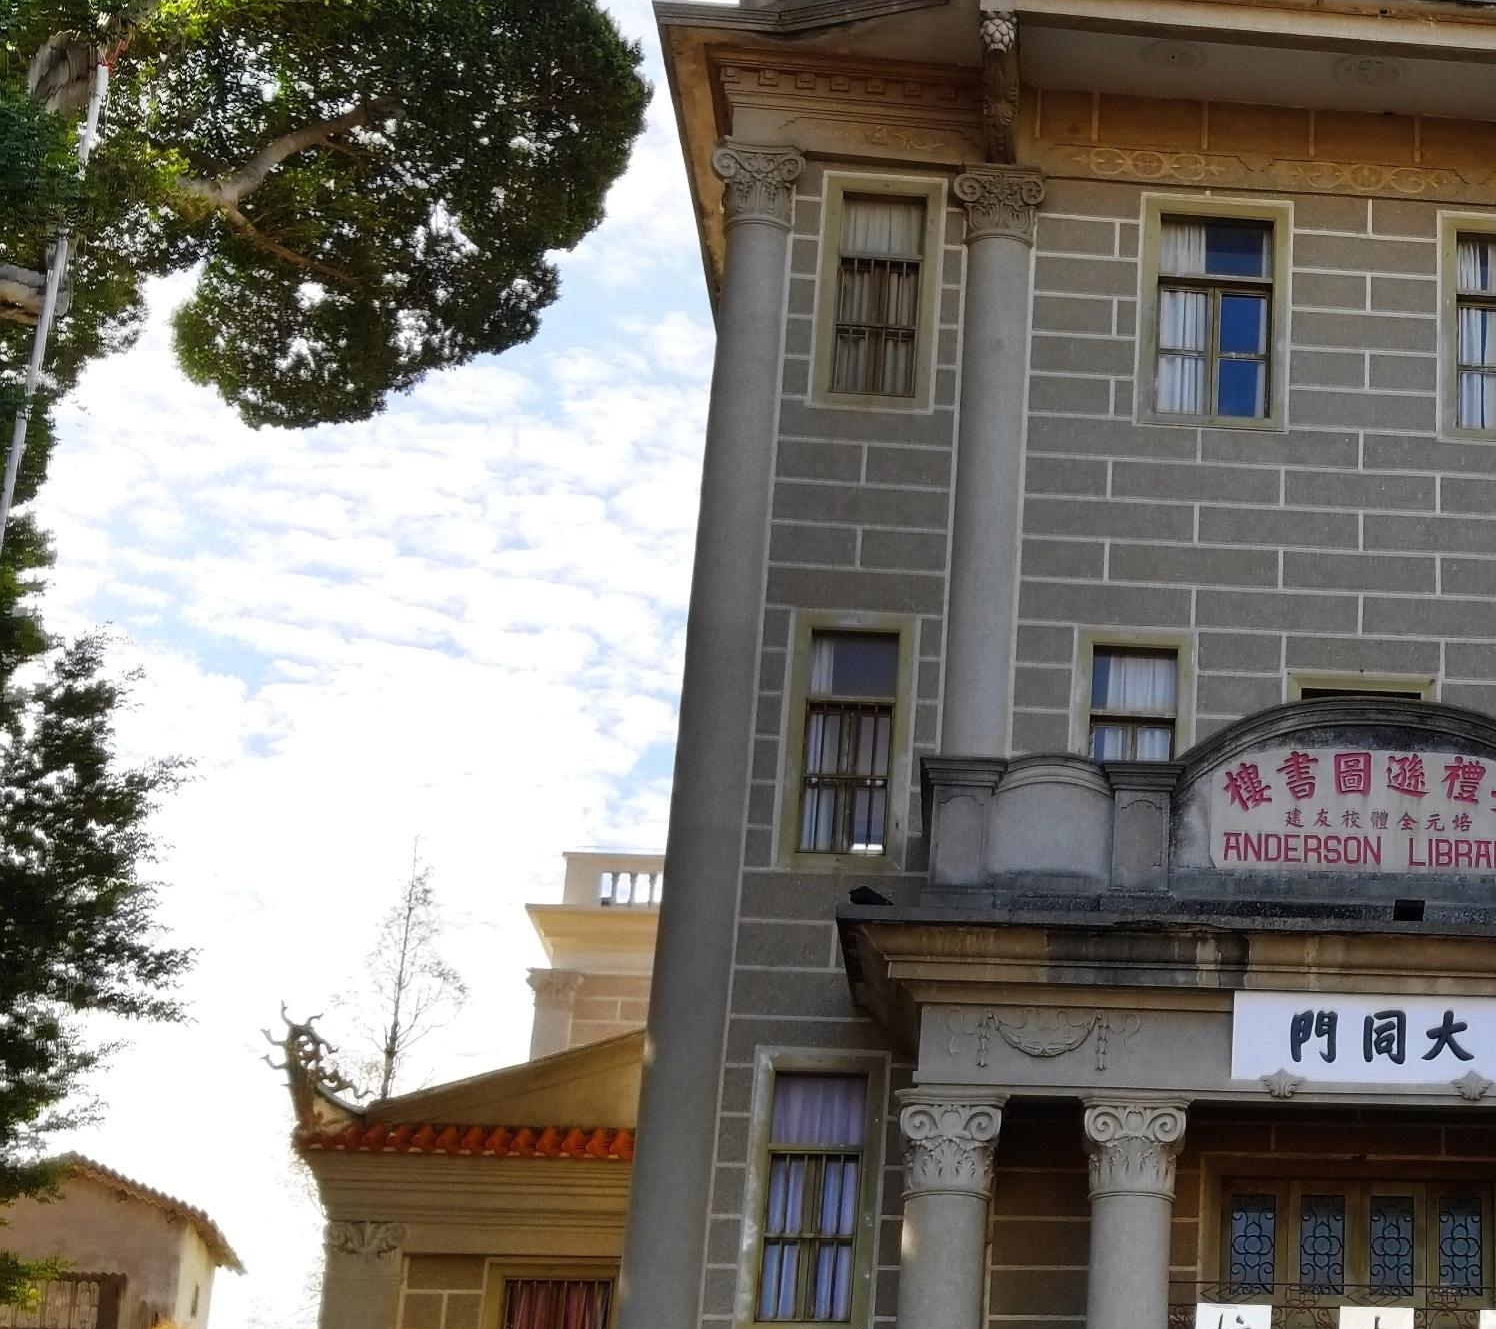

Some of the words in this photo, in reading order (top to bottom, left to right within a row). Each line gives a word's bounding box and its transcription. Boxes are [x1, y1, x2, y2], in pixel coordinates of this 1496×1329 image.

[1284, 806, 1474, 833] 培元全體校友建
[1223, 831, 1383, 866] ANDERSON
[1289, 1008, 1476, 1065] 大同門
